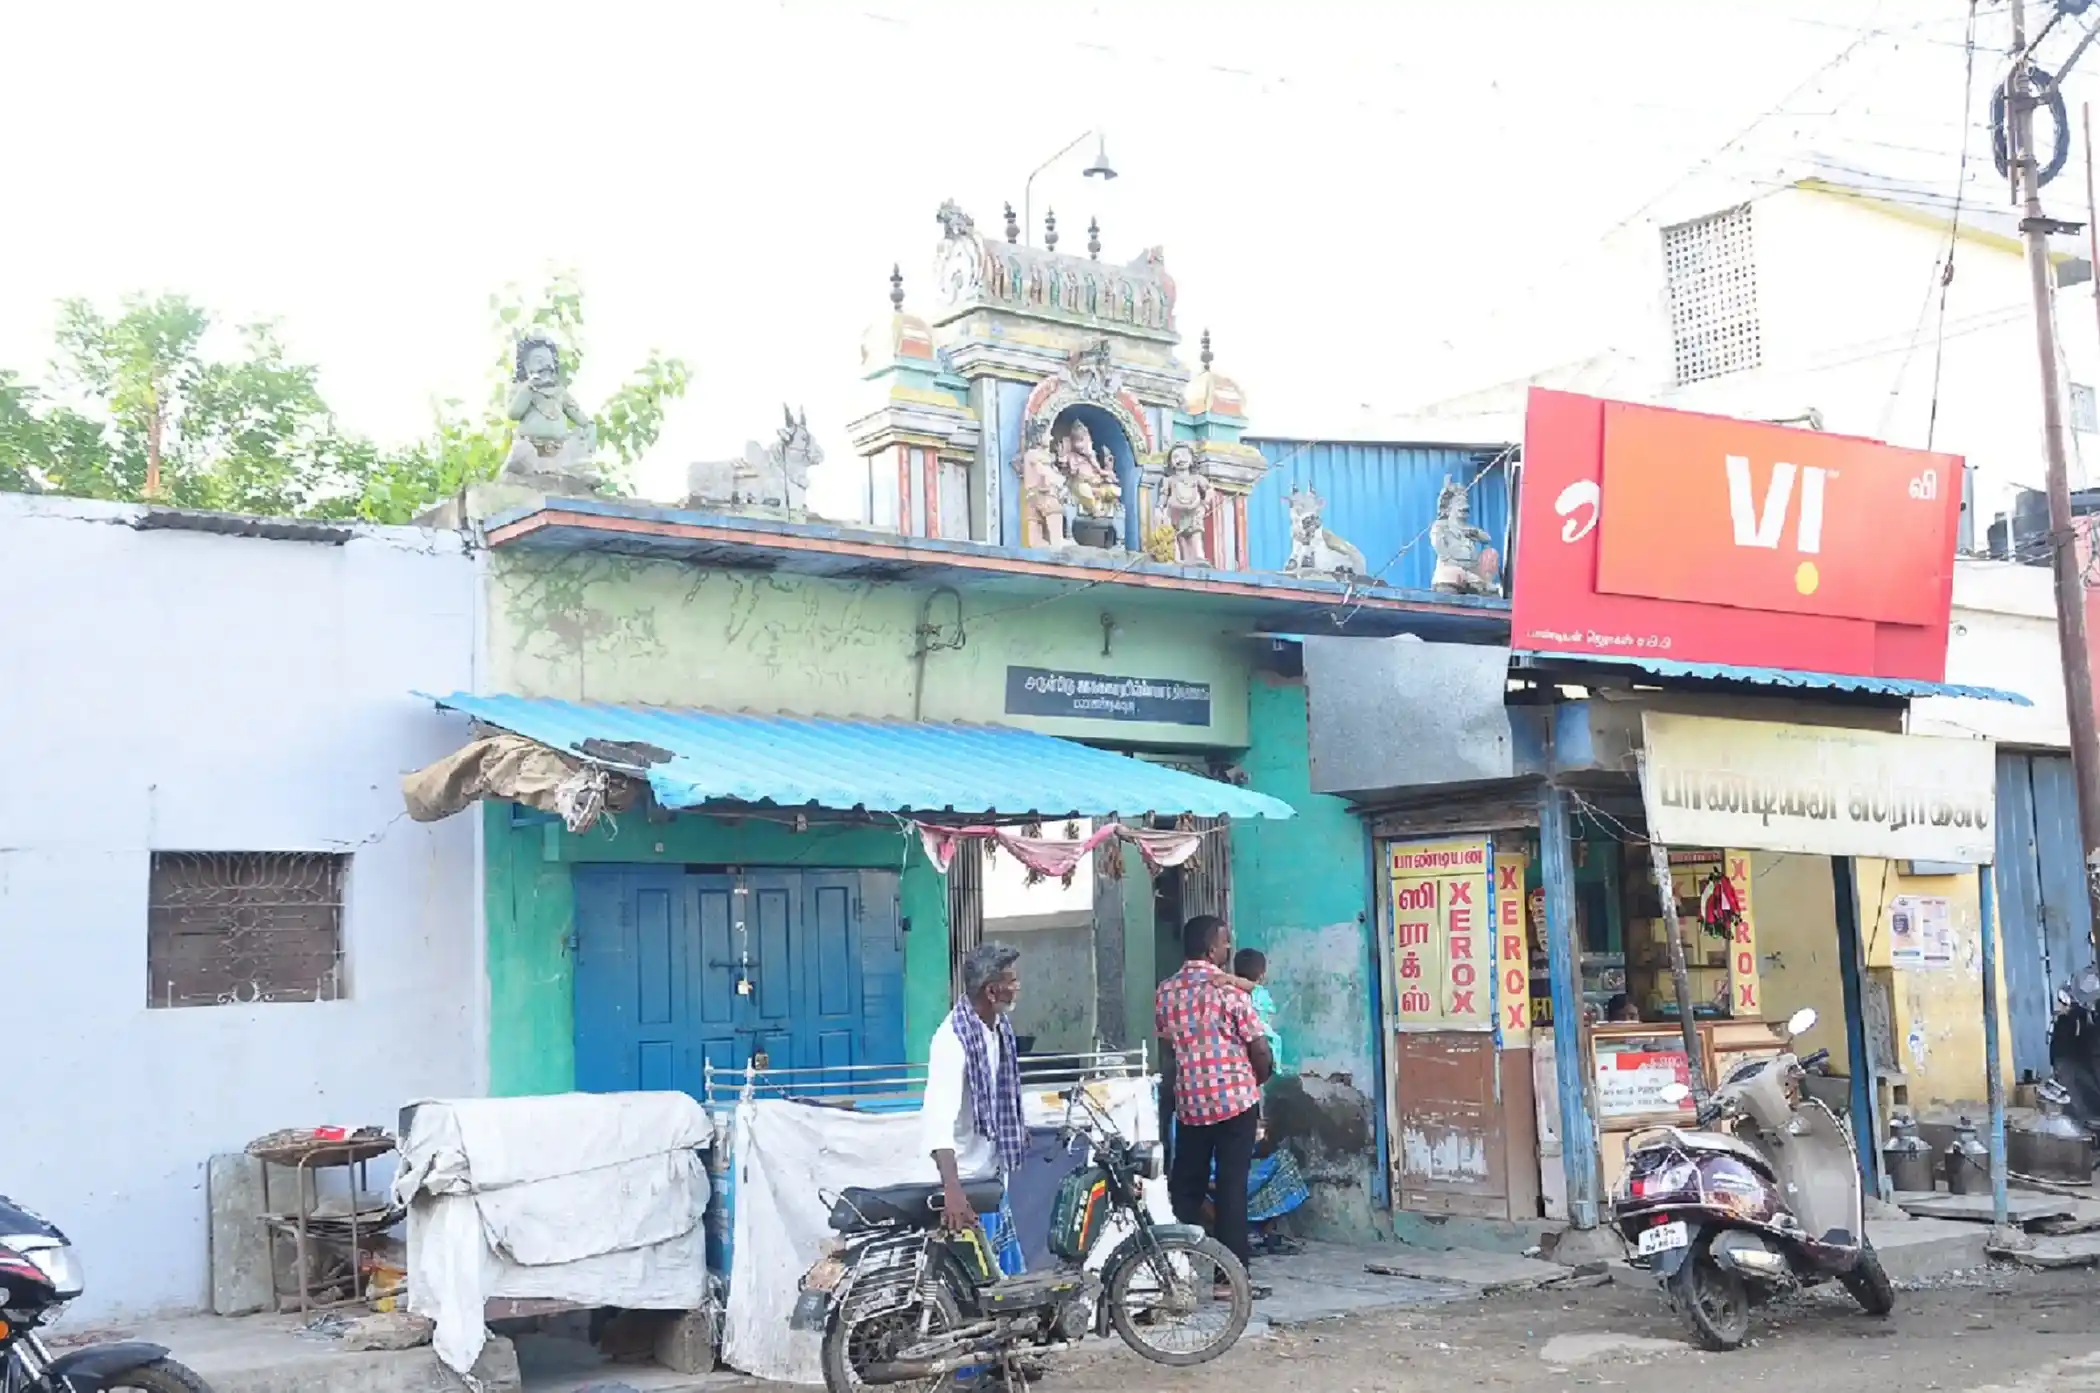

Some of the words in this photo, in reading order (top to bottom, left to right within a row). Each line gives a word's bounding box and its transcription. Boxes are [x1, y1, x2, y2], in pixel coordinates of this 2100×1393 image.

[1908, 468, 1937, 501] வி
[1393, 846, 1484, 870] பாண்டியன்
[1448, 881, 1477, 1014] XEROX
[1500, 865, 1525, 1030] XEROX
[1730, 858, 1756, 1008] XEROX
